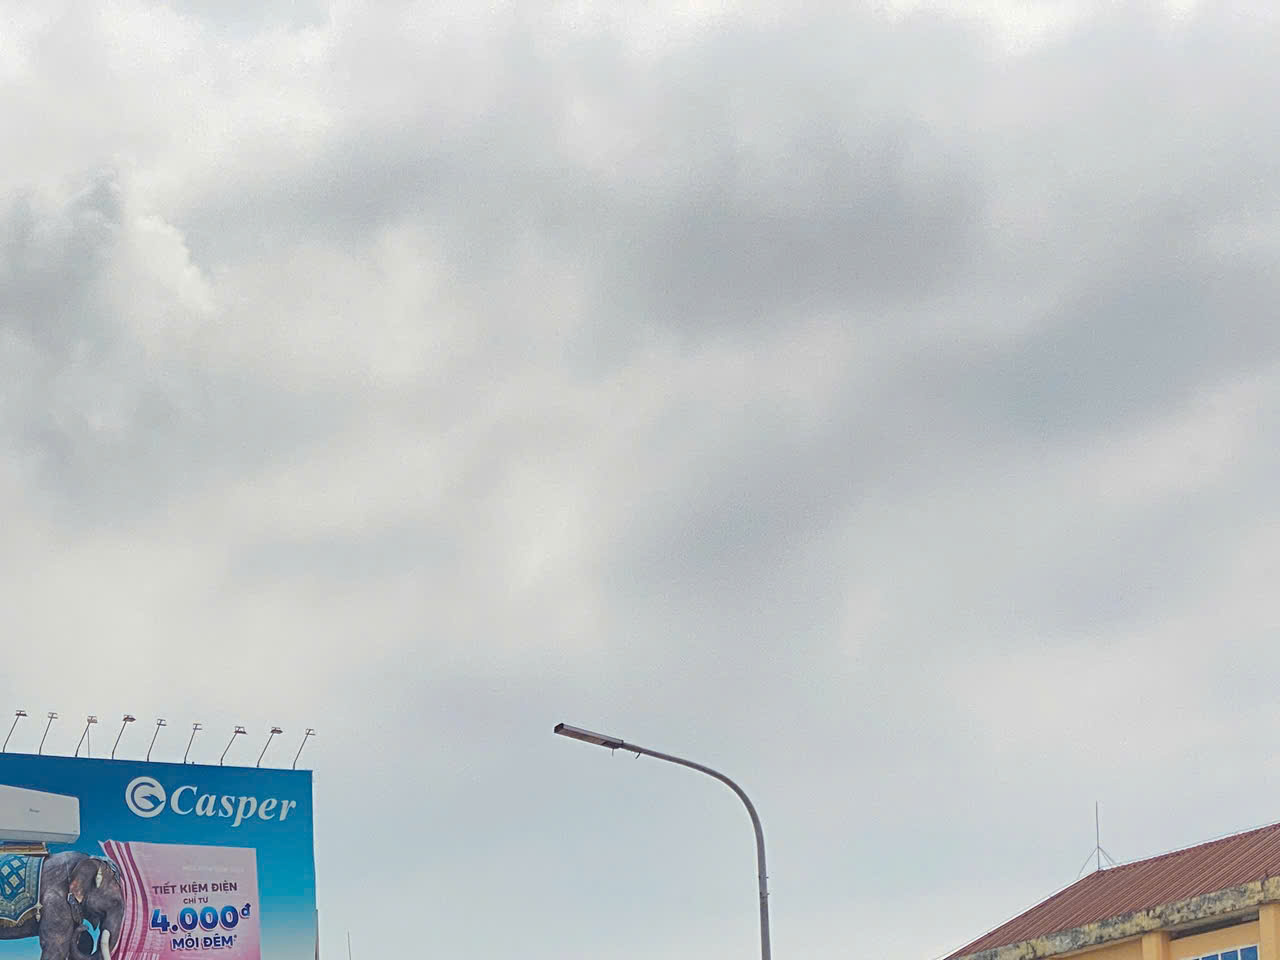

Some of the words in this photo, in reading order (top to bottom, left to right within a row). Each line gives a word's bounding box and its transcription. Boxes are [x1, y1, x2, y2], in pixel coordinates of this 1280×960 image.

[170, 785, 297, 828] Casper
[152, 881, 176, 895] TIẾT
[180, 882, 208, 896] KIỆM
[211, 880, 238, 894] ĐIỆN
